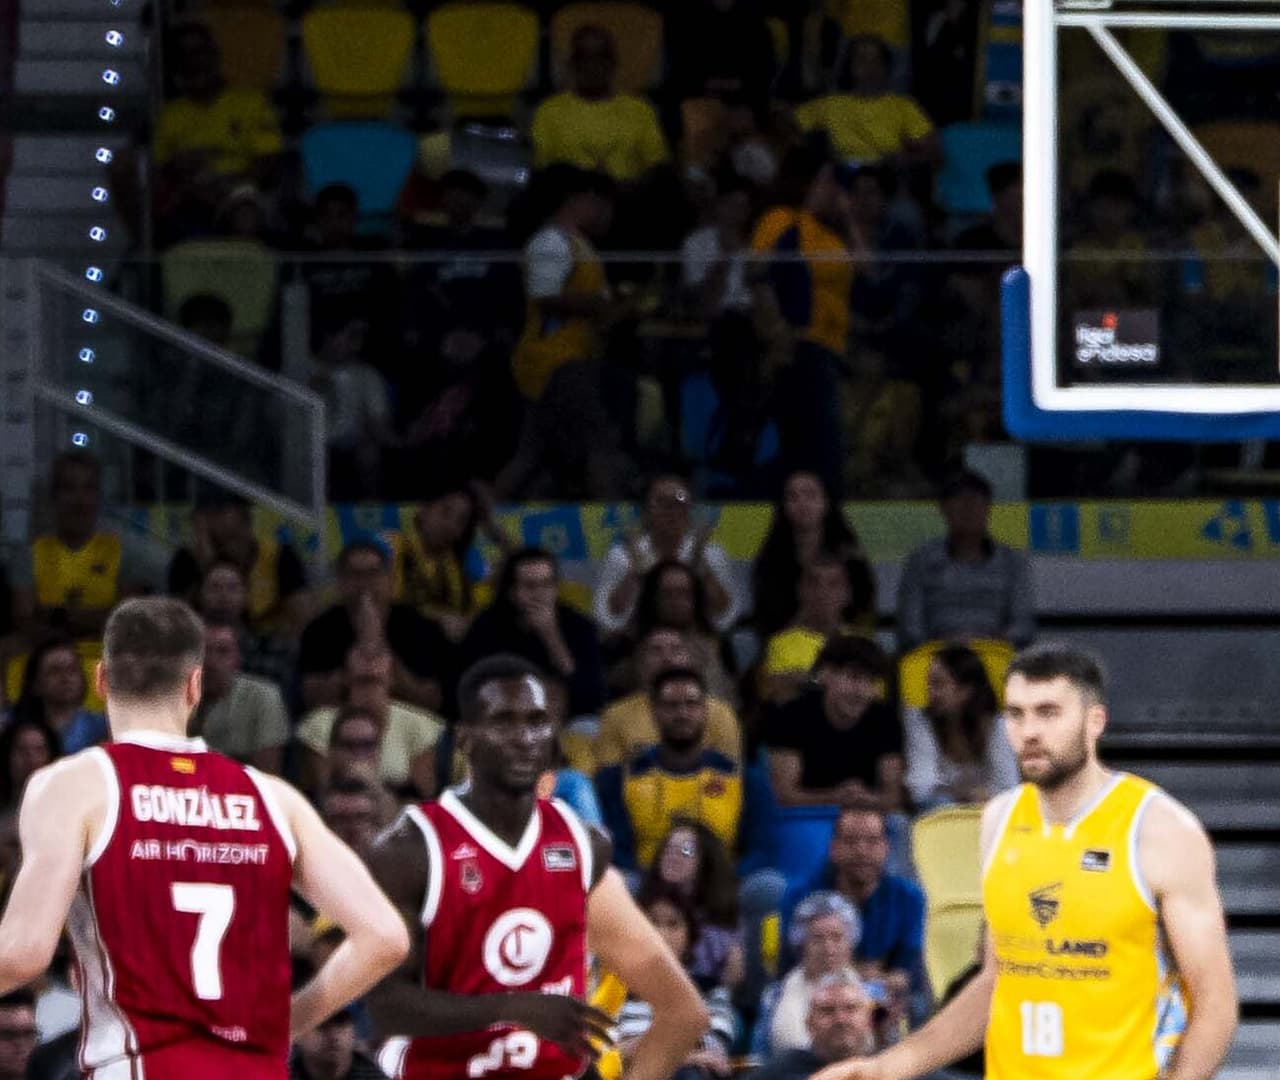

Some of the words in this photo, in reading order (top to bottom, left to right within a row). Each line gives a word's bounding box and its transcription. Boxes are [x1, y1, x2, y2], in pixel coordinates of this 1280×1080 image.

[130, 784, 260, 831] GONZÁLEZ
[130, 839, 161, 861] AIR
[166, 839, 269, 865] HORIZONT
[171, 882, 235, 1001] 7
[1020, 1001, 1064, 1057] 18
